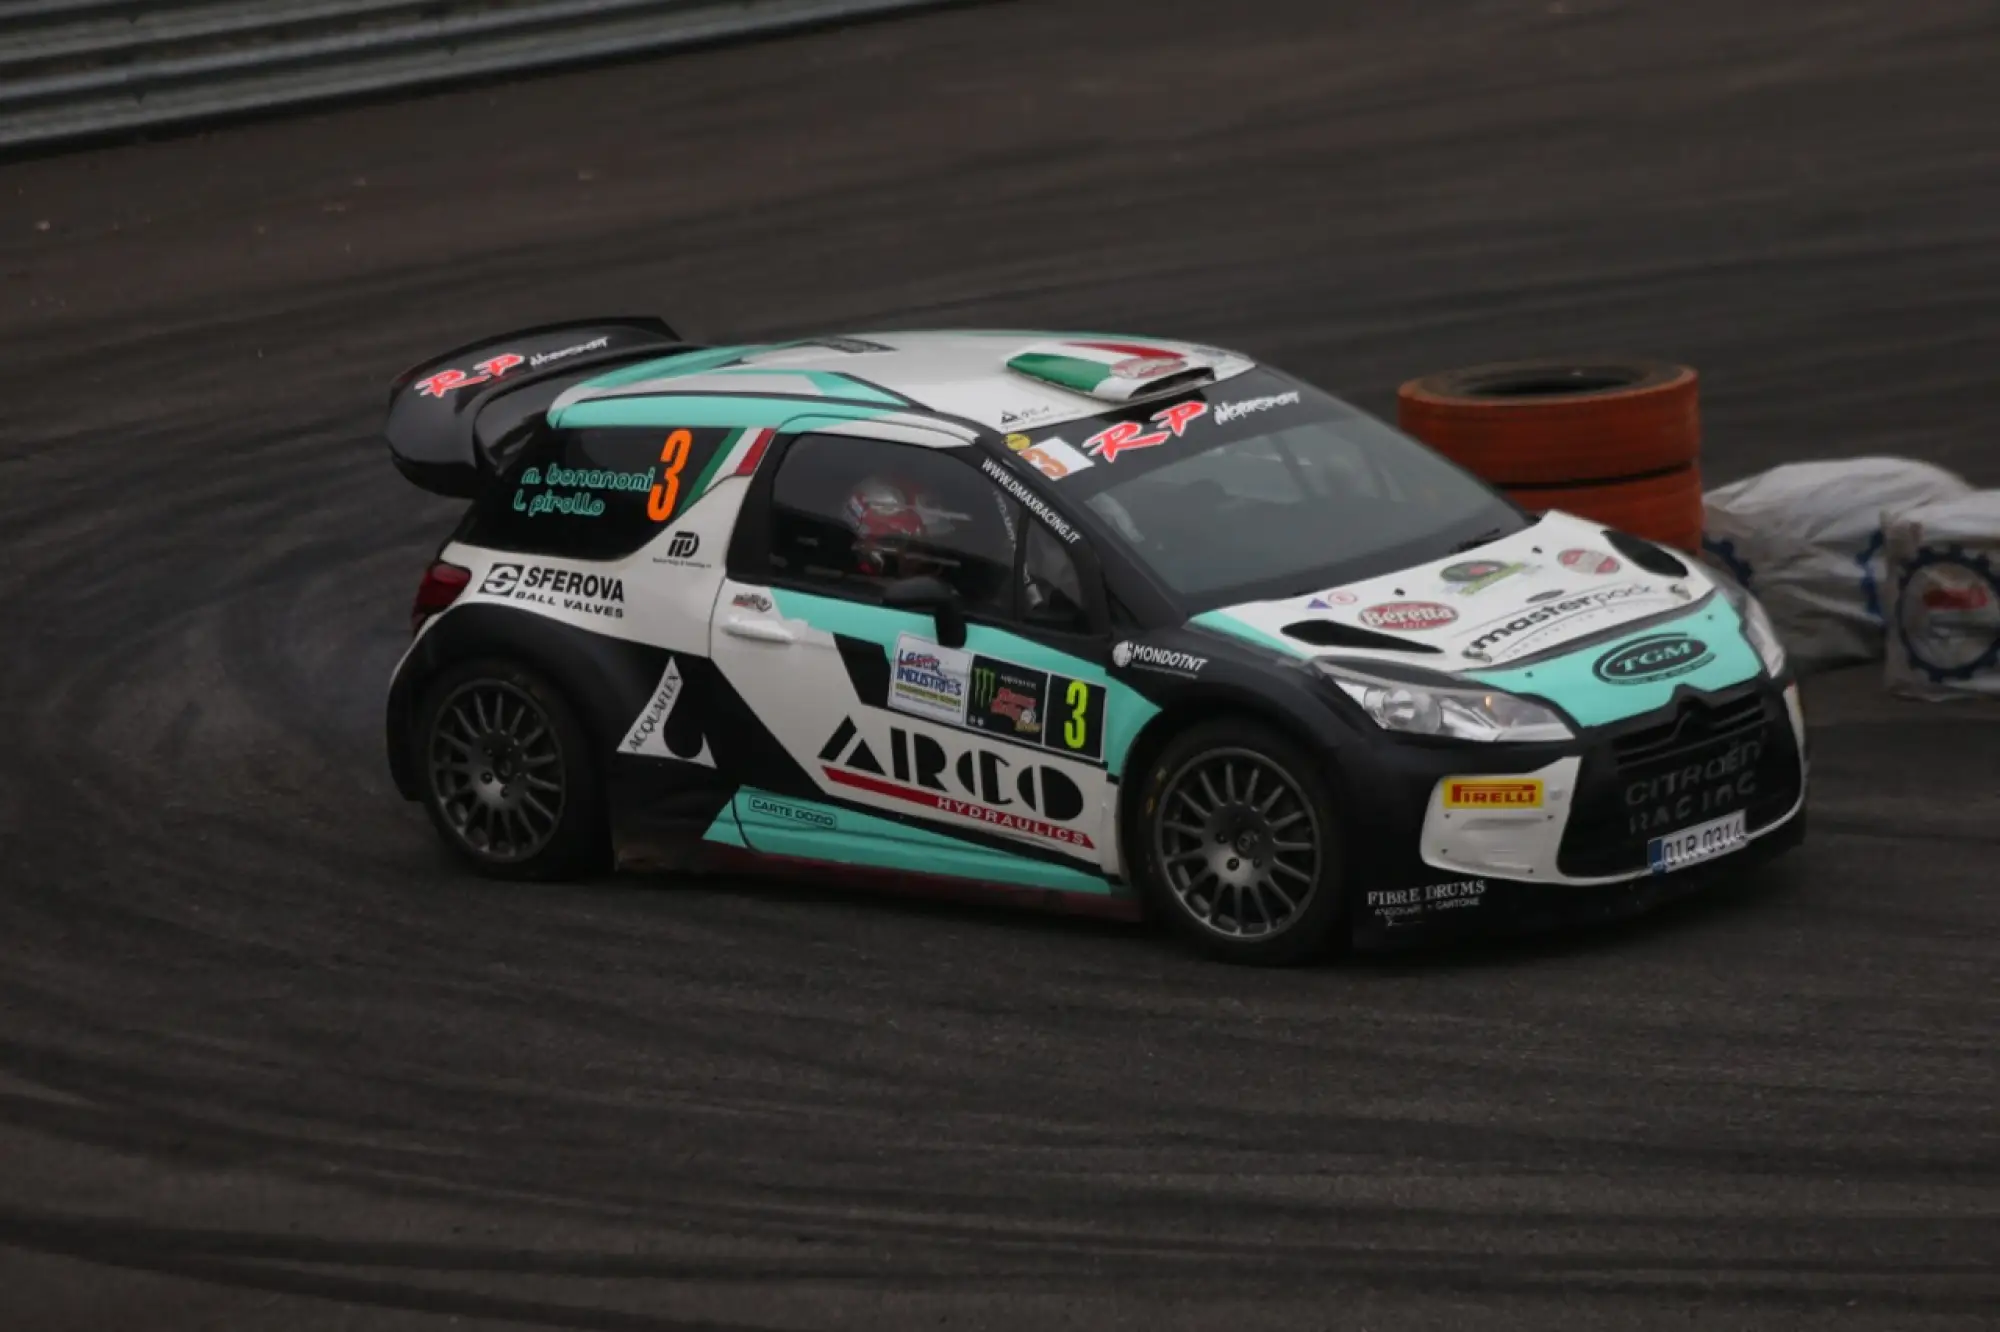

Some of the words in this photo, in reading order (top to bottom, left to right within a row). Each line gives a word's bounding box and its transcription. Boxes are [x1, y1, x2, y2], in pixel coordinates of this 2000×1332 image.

[546, 463, 656, 493] bonanomi
[647, 428, 692, 522] 3
[523, 565, 625, 603] SFEROVA
[513, 591, 557, 607] BALL
[563, 599, 624, 619] VALVES
[1360, 604, 1453, 628] Beretta
[1132, 643, 1209, 672] MONDOTNT
[1616, 641, 1691, 673] TGM
[896, 667, 962, 696] INDUSTRIES
[628, 672, 680, 752] ACQUAFLEX
[1063, 679, 1089, 749] 3
[816, 715, 1085, 822] ARCO
[752, 799, 793, 817] CARTE
[1452, 783, 1537, 804] PIRELLI
[936, 796, 1087, 847] HYDRAULICS
[1367, 887, 1421, 905] FIBRE
[1425, 880, 1485, 900] DRUMS
